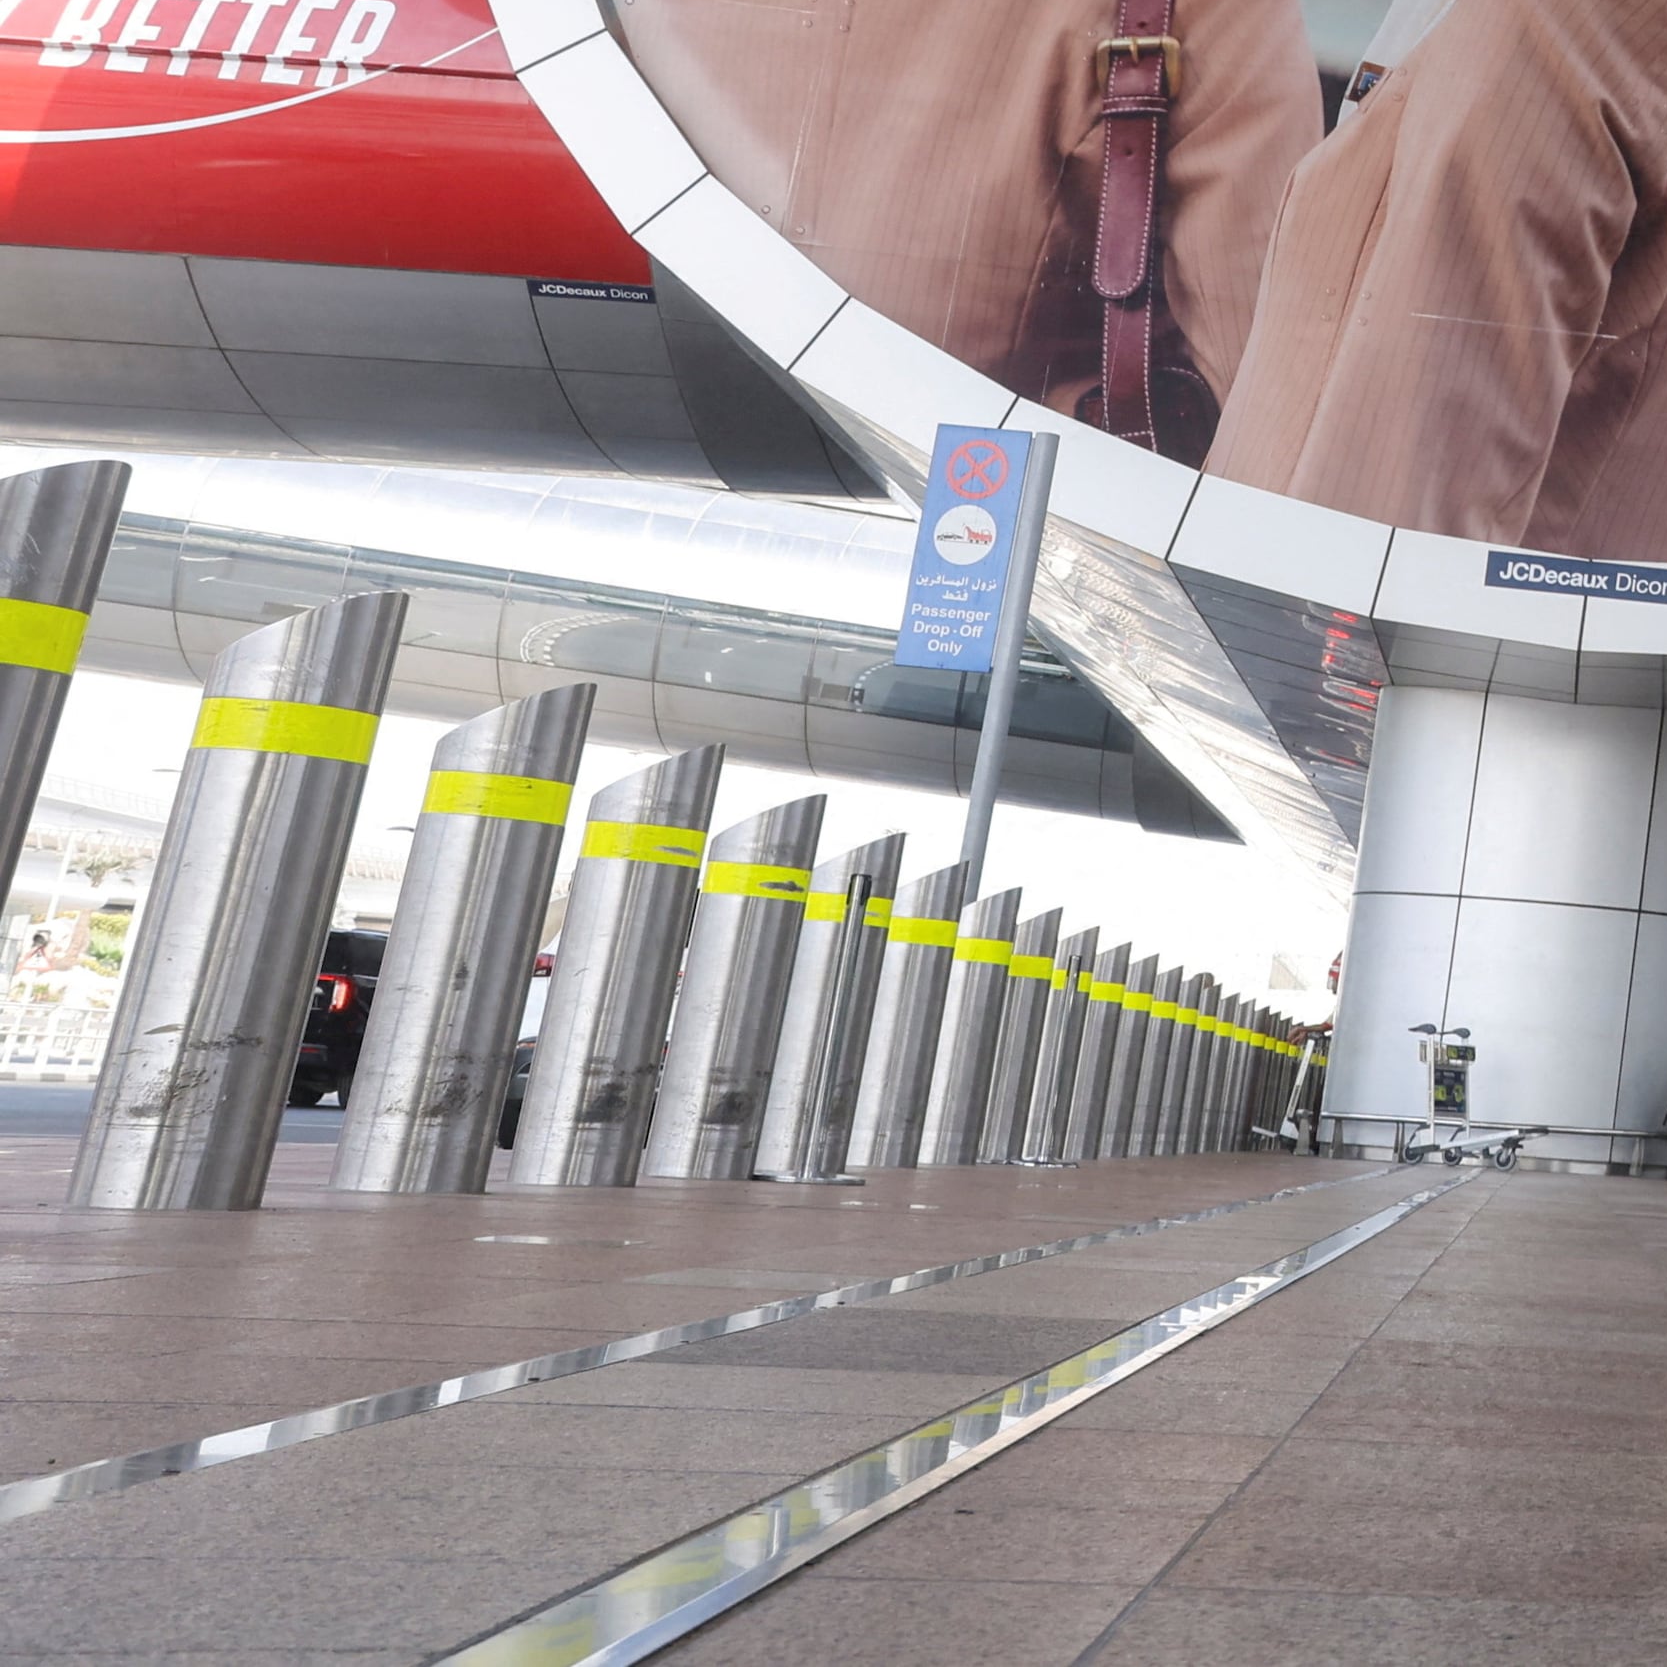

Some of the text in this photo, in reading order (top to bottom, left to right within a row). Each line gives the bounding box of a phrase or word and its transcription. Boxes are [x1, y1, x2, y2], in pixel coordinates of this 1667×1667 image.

[539, 284, 649, 301] JCDecaux Dicon
[1499, 561, 1609, 591] JCDecaux
[942, 589, 969, 602] فقط
[911, 603, 991, 623] Passenger
[927, 638, 963, 657] Only
